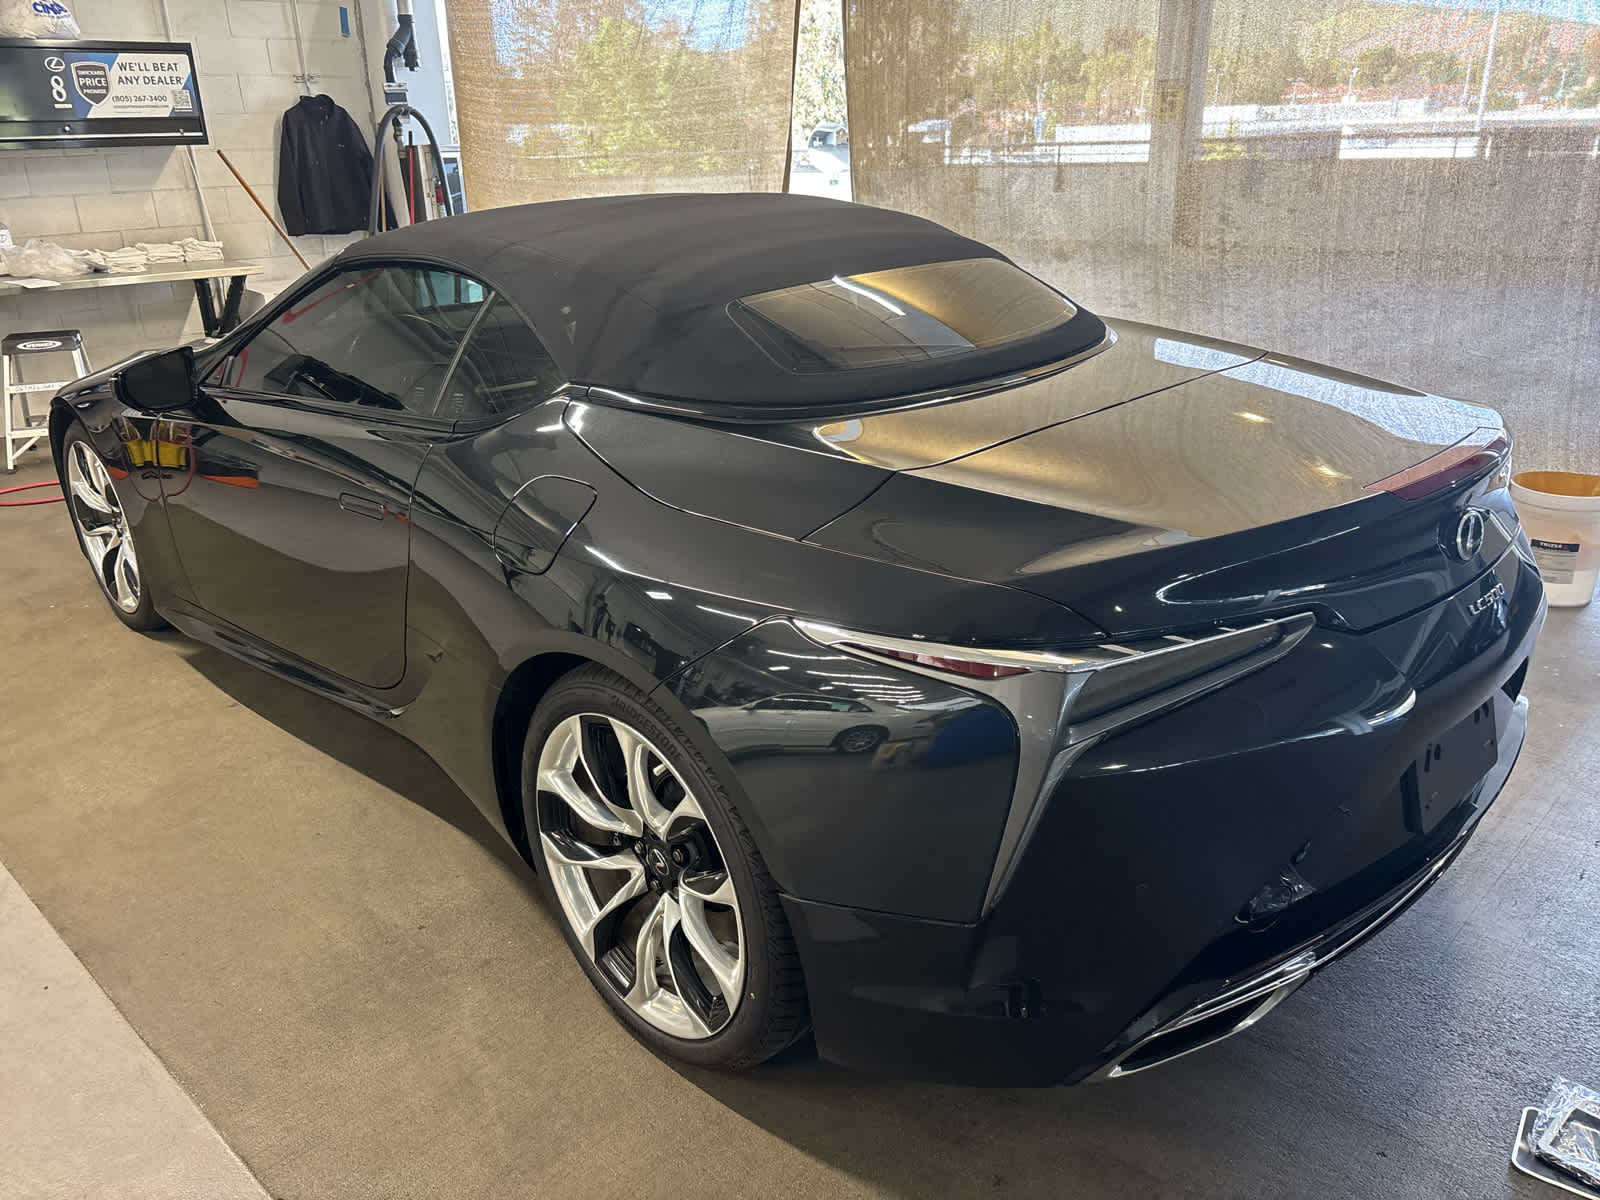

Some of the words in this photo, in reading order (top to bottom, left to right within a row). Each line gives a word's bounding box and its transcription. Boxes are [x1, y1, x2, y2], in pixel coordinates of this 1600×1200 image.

[117, 62, 150, 72] WE'LL
[152, 62, 178, 72] BEAT
[79, 78, 107, 87] PRICE
[118, 76, 140, 85] ANY
